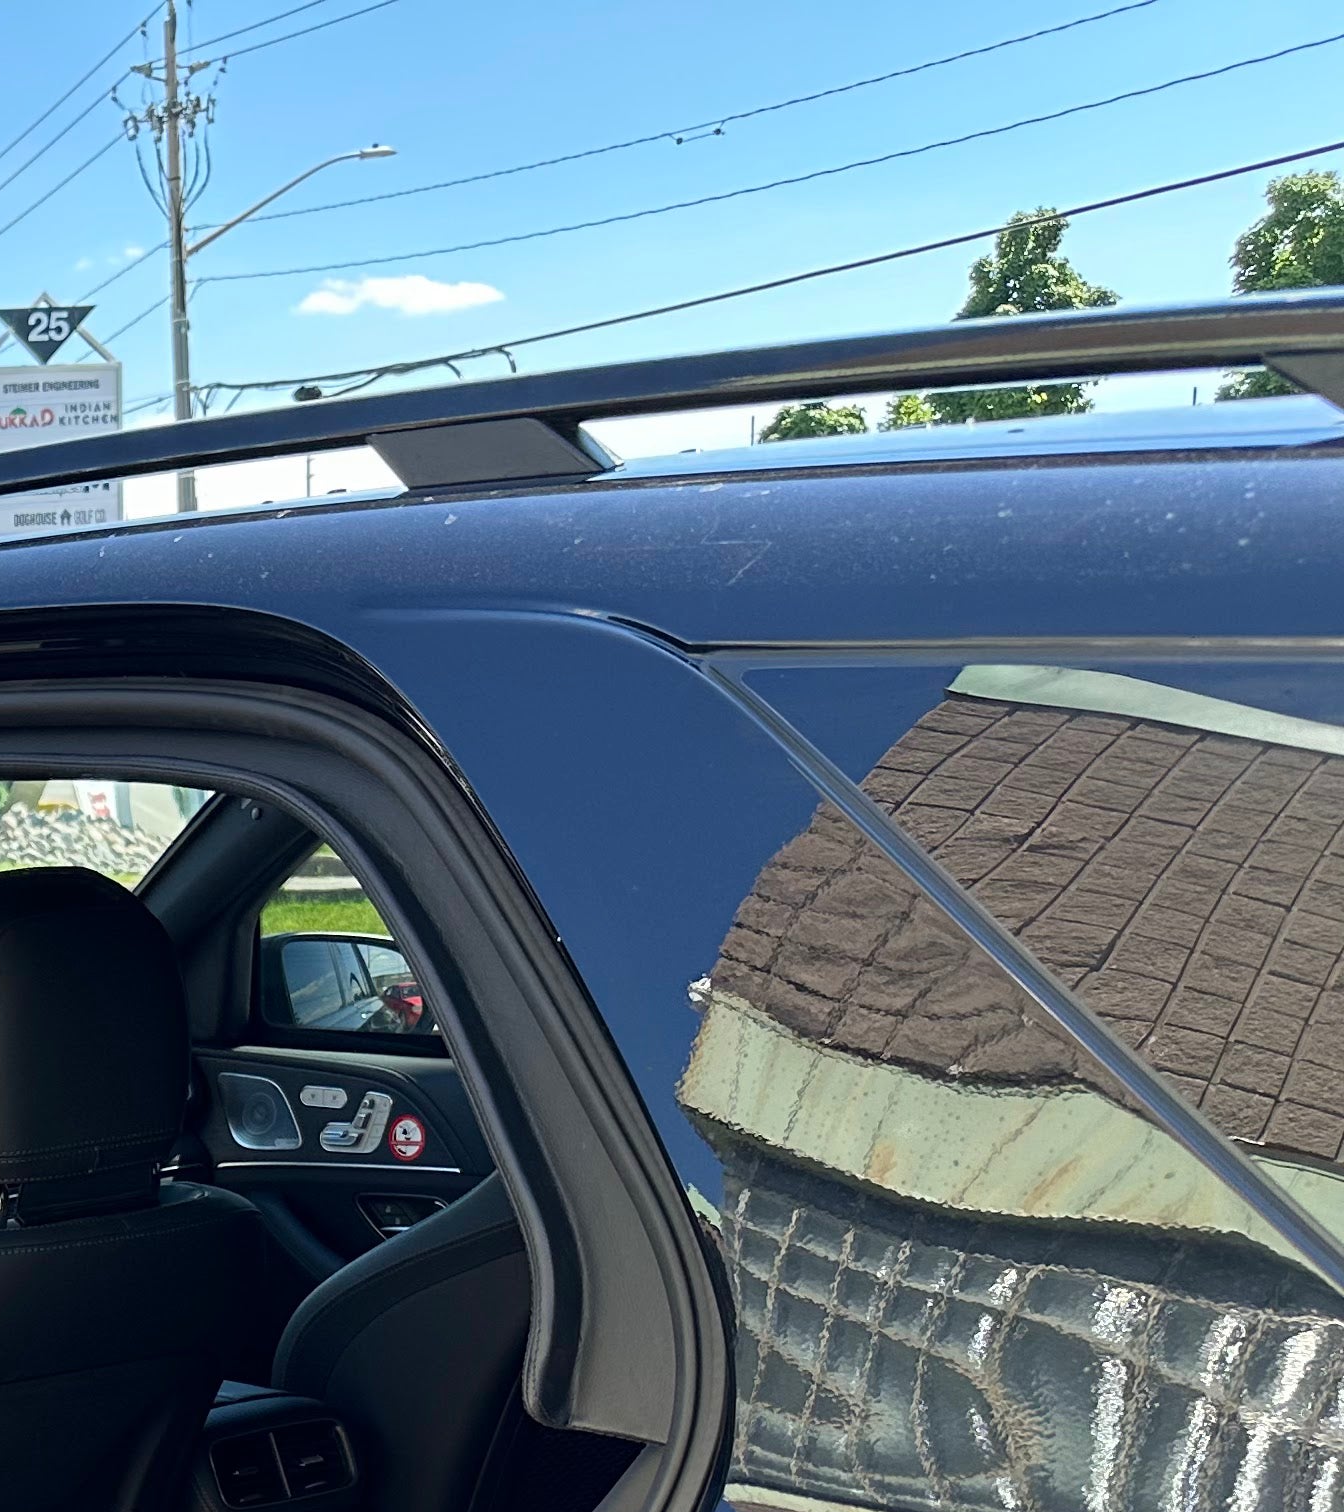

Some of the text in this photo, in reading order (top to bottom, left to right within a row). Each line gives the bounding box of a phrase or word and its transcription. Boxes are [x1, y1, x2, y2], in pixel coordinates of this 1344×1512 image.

[27, 311, 70, 342] 25
[2, 382, 40, 394] STEINER
[42, 380, 100, 392] ENGINEERING
[64, 401, 112, 413] INDIAN
[58, 414, 119, 426] KITCHEN
[13, 512, 57, 527] DOGHOUSE
